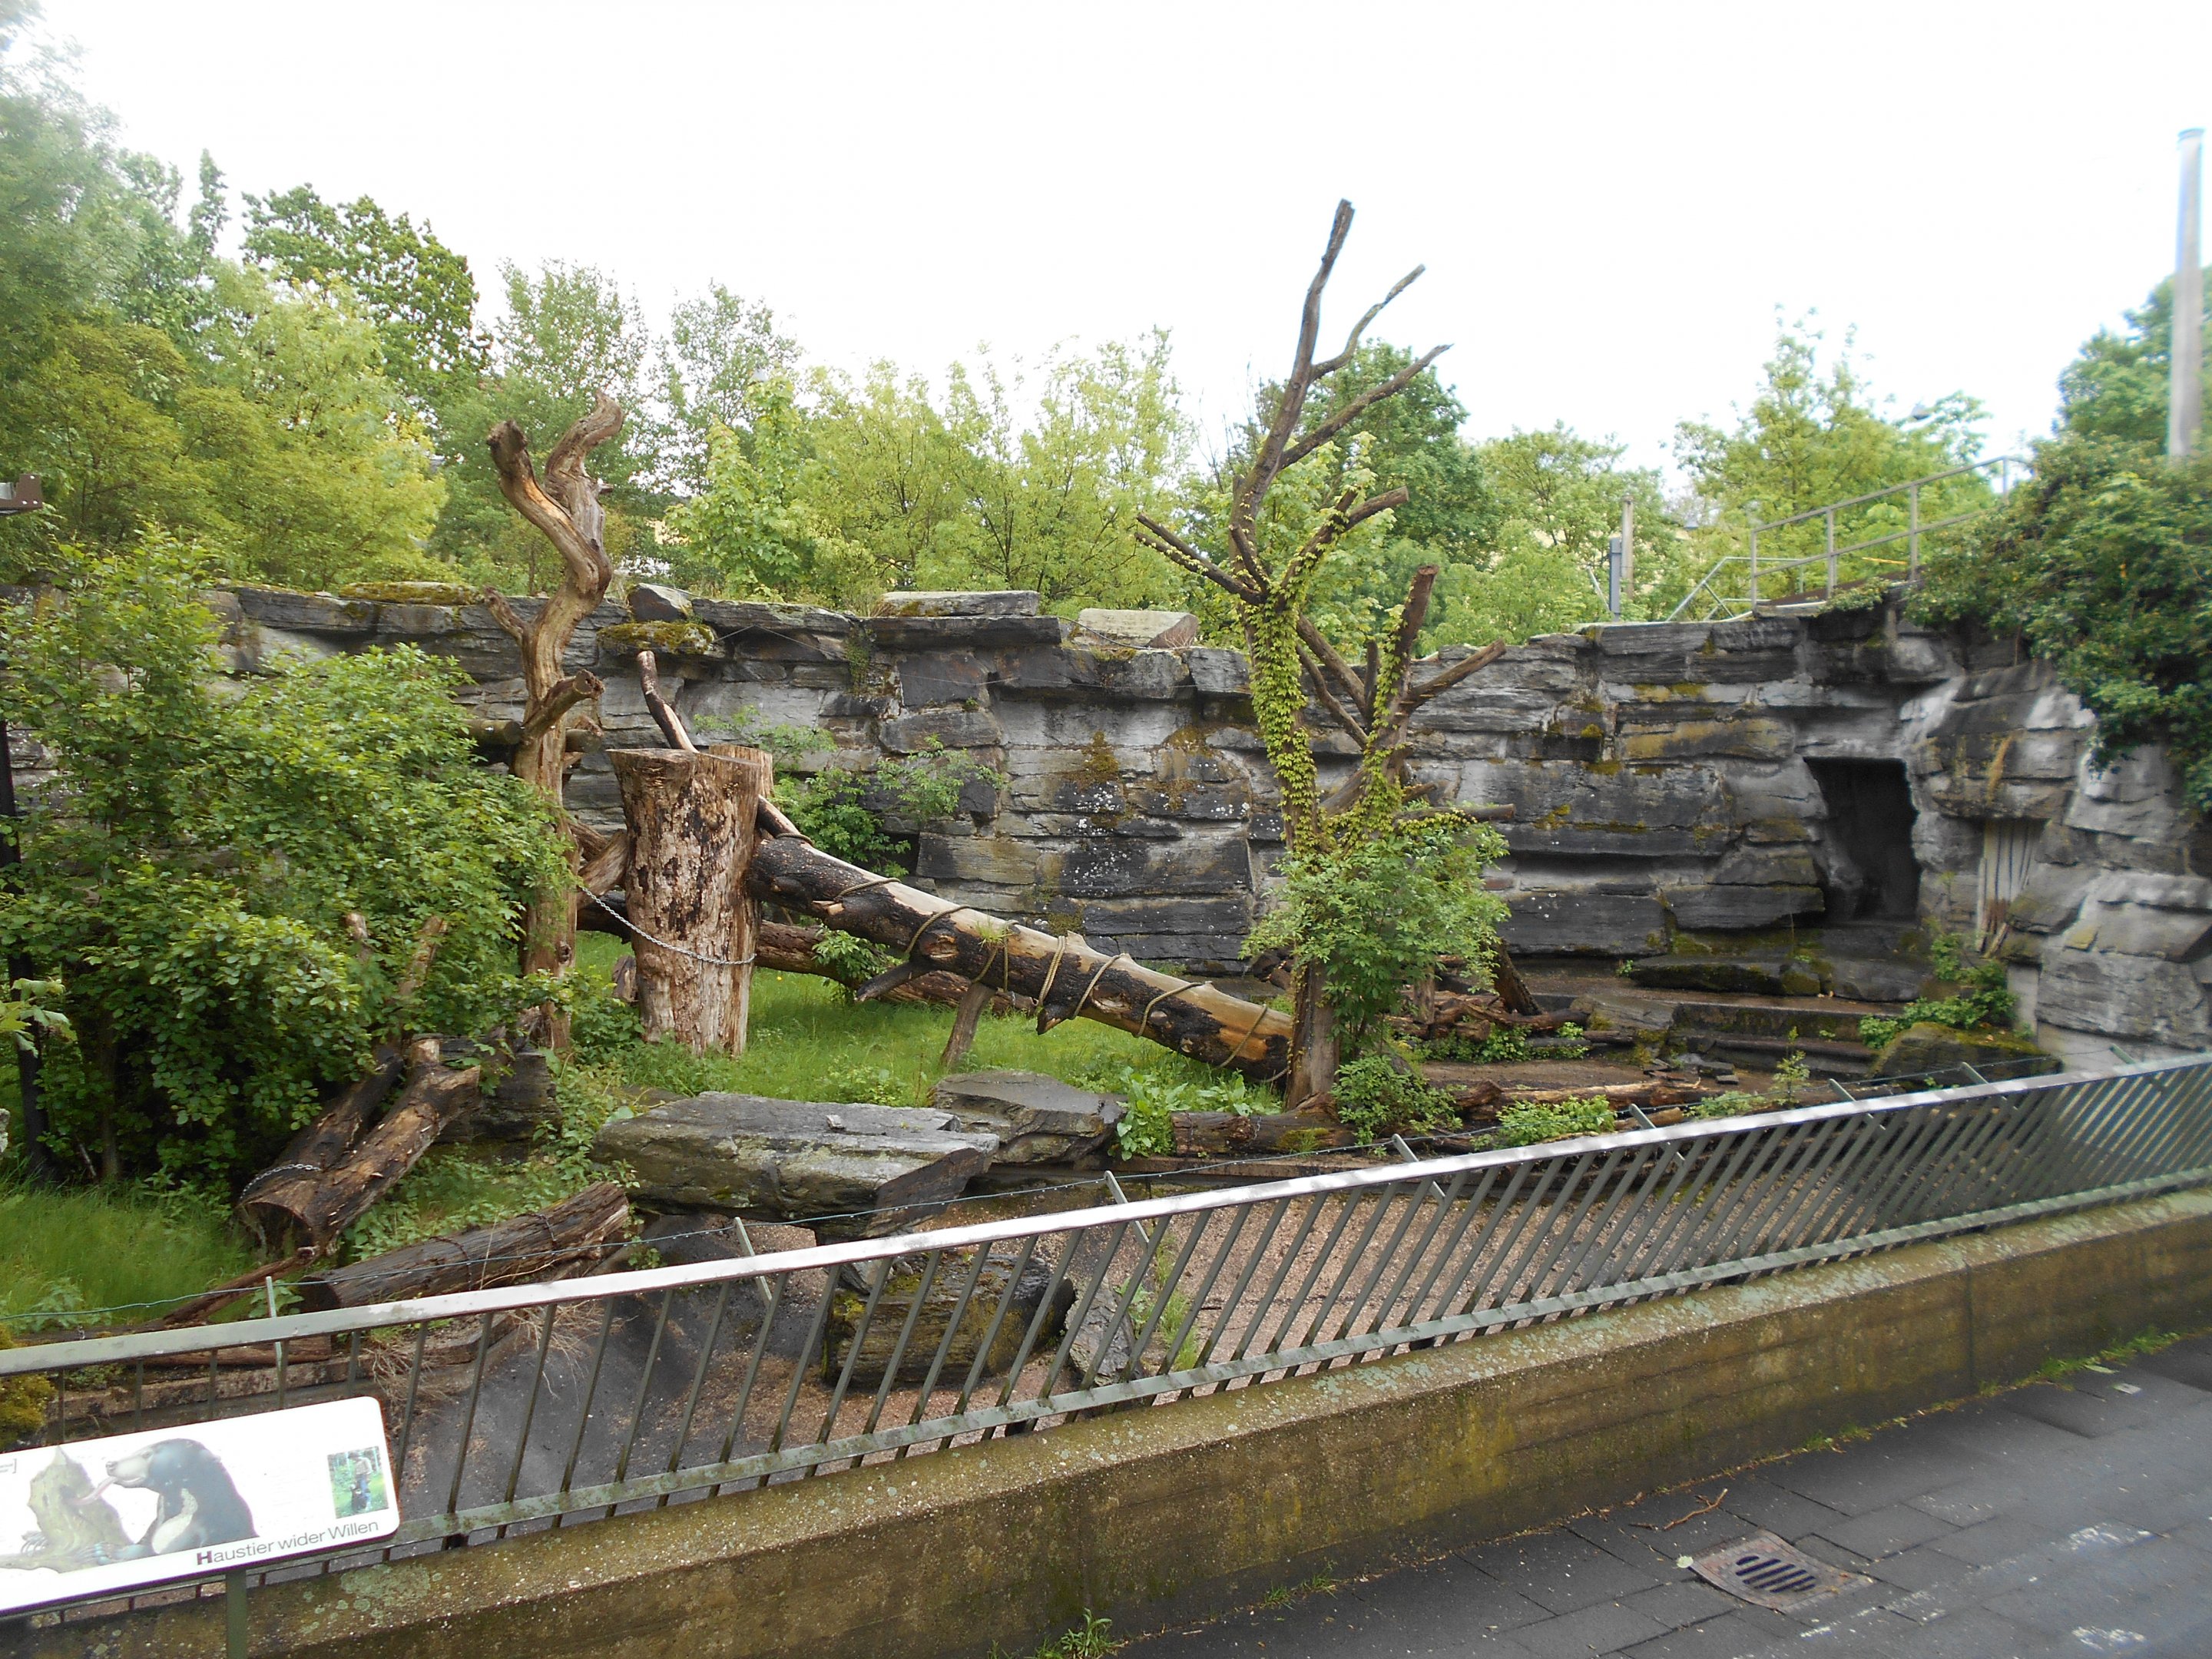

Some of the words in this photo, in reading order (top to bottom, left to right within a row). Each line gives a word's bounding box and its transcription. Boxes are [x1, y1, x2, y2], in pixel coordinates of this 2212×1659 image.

[197, 1541, 274, 1565] Haustier
[278, 1532, 325, 1549] wider
[328, 1522, 379, 1539] Willen
